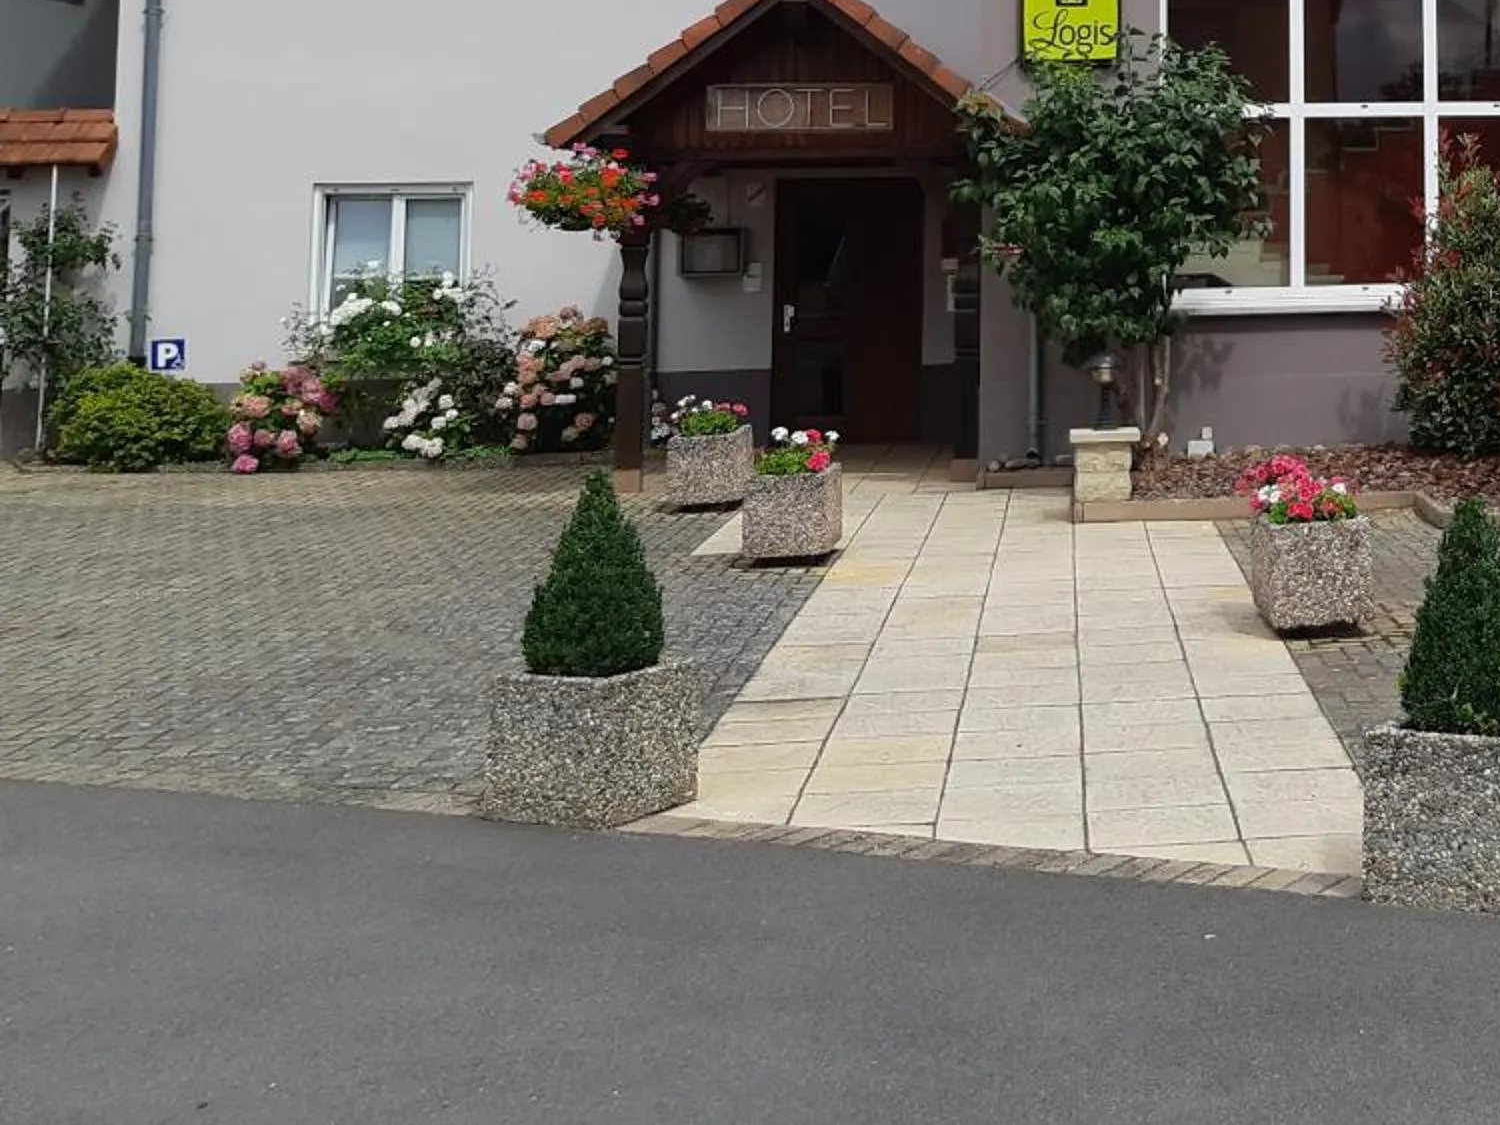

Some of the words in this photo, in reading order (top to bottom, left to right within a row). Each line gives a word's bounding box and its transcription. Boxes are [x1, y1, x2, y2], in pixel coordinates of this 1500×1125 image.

[1028, 9, 1114, 57] Logis
[716, 87, 888, 127] HOTEL
[157, 343, 179, 368] P
